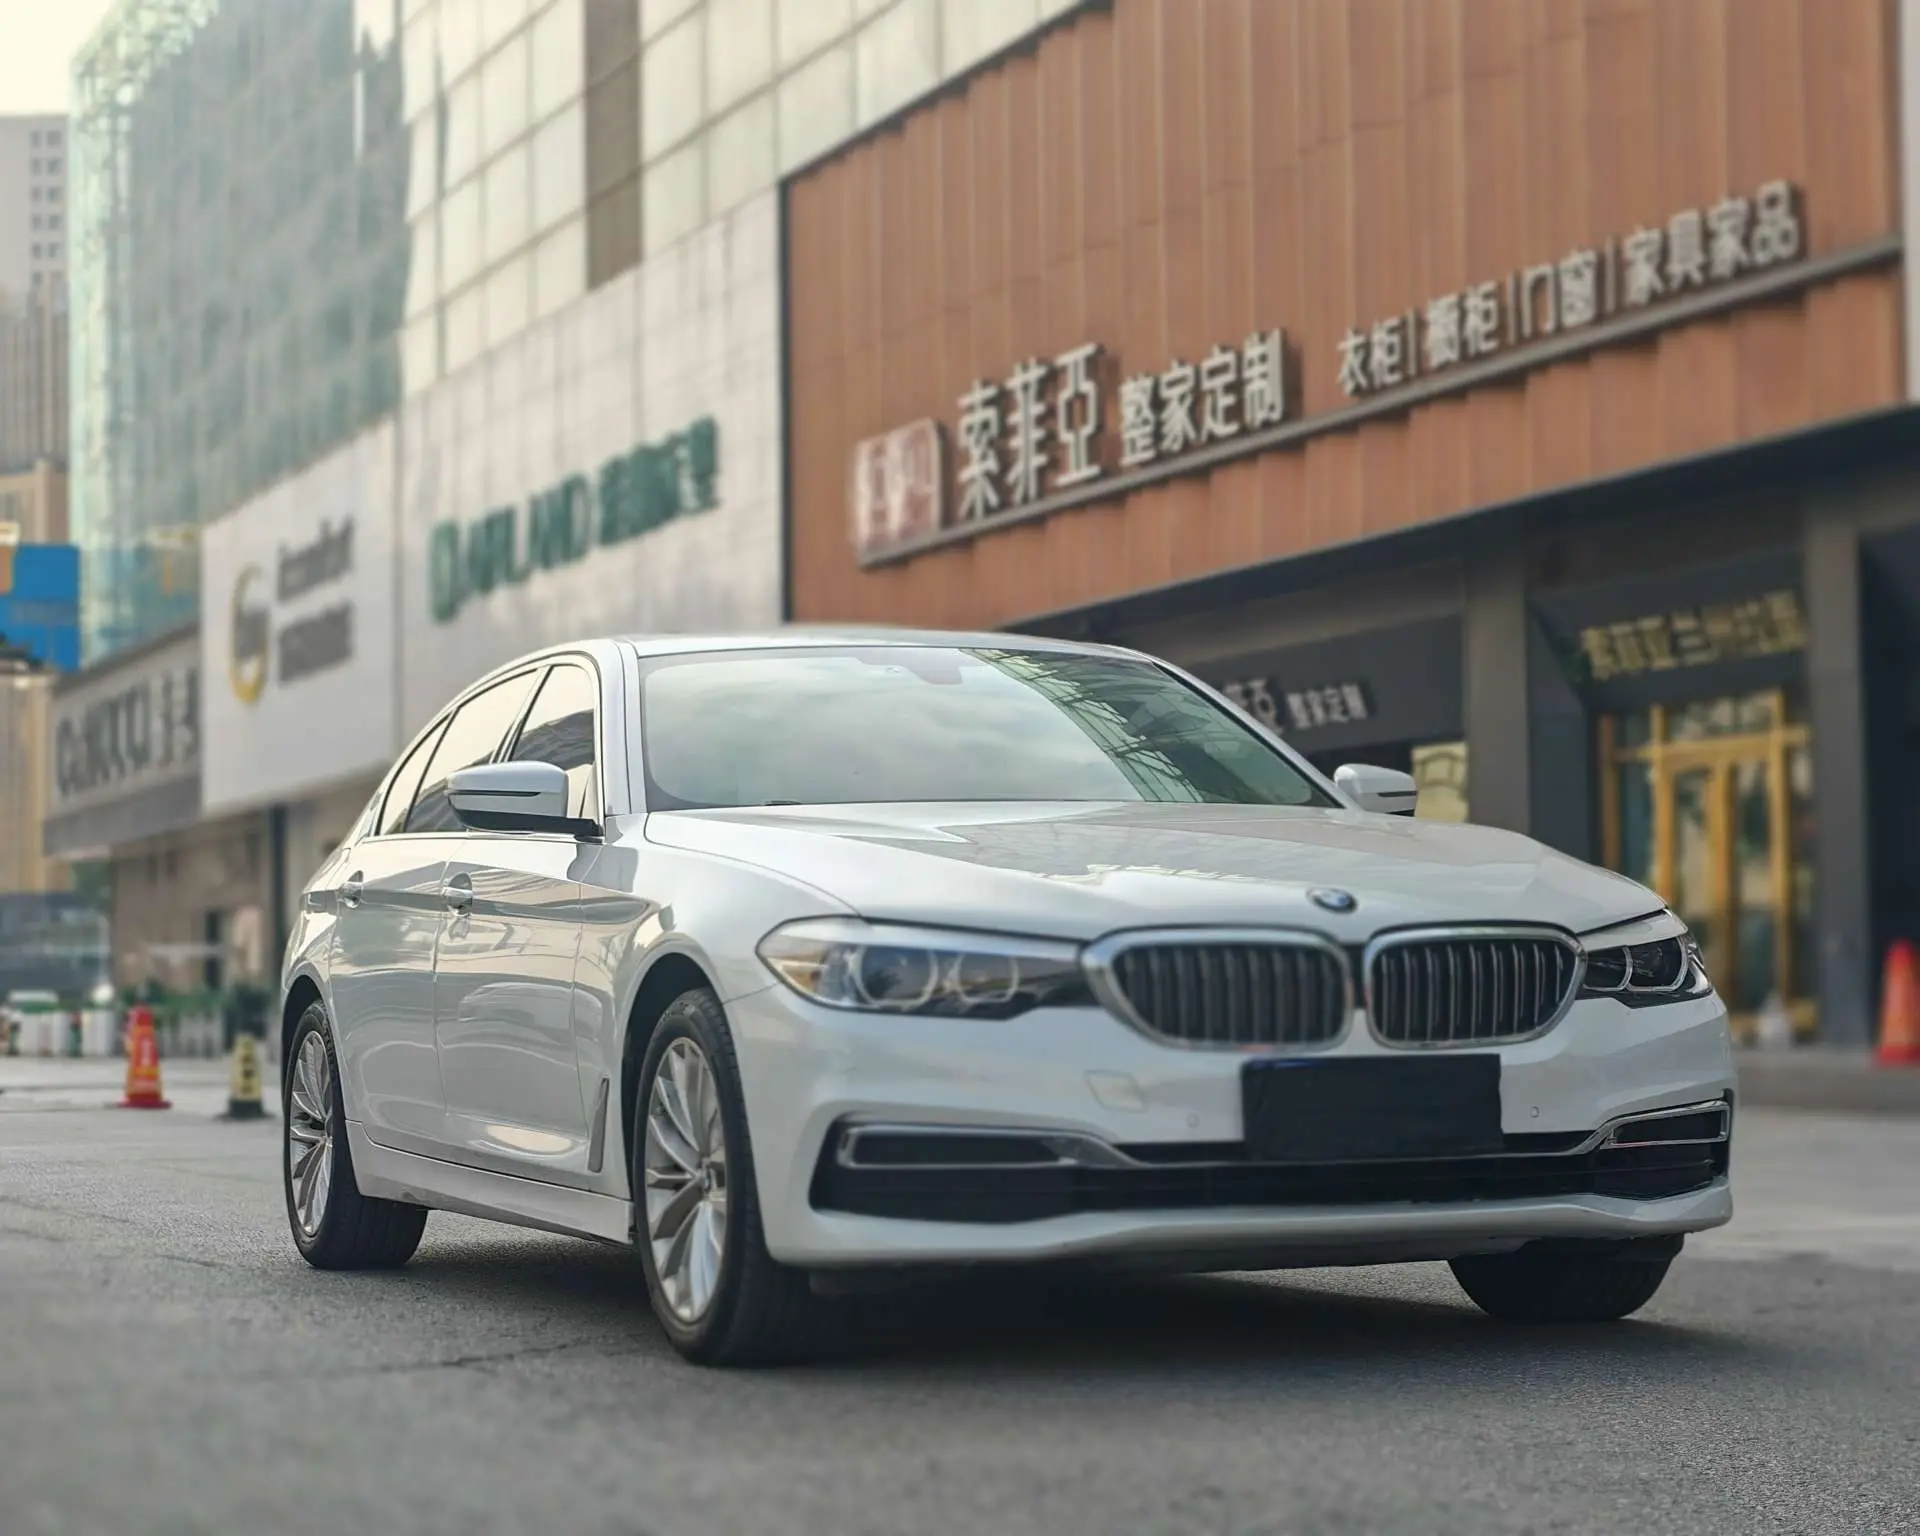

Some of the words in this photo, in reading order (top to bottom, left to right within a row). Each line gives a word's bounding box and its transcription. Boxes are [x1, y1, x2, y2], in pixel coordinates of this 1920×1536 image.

[957, 341, 1101, 520] 索菲亞
[1118, 327, 1284, 467] 整家定制
